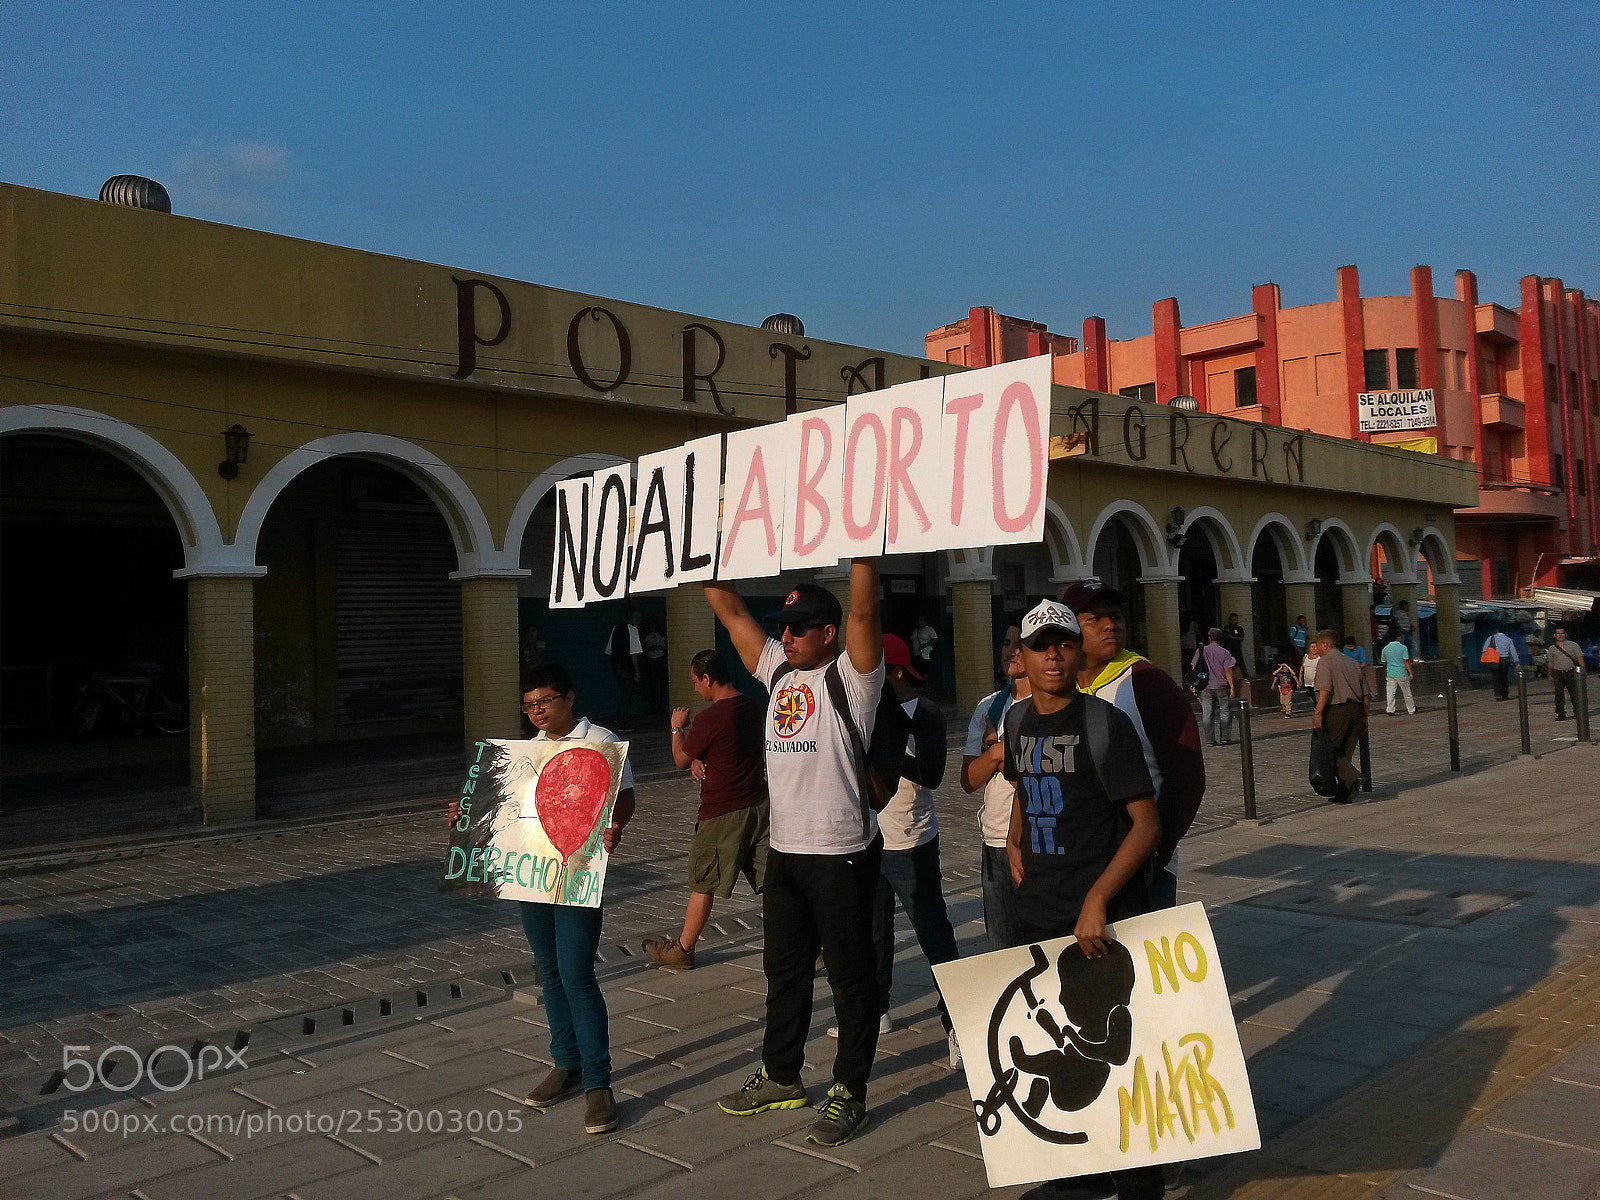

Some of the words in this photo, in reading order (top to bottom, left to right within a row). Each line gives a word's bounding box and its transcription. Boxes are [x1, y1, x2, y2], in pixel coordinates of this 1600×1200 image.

[450, 274, 930, 415] PORTA
[1360, 395, 1374, 405] SE
[1378, 391, 1432, 405] ALQUILAN
[1371, 405, 1427, 416] LOCALES
[554, 471, 629, 604] NO
[630, 451, 712, 579] AL
[721, 380, 1045, 569] ABORTO
[773, 741, 817, 752] SALVADOR
[1016, 734, 1080, 774] JUST
[1022, 776, 1064, 815] DO
[444, 845, 560, 893] DERECHO
[563, 867, 600, 905] VIDA
[1143, 931, 1208, 995] NO
[1117, 1032, 1235, 1154] MATAR
